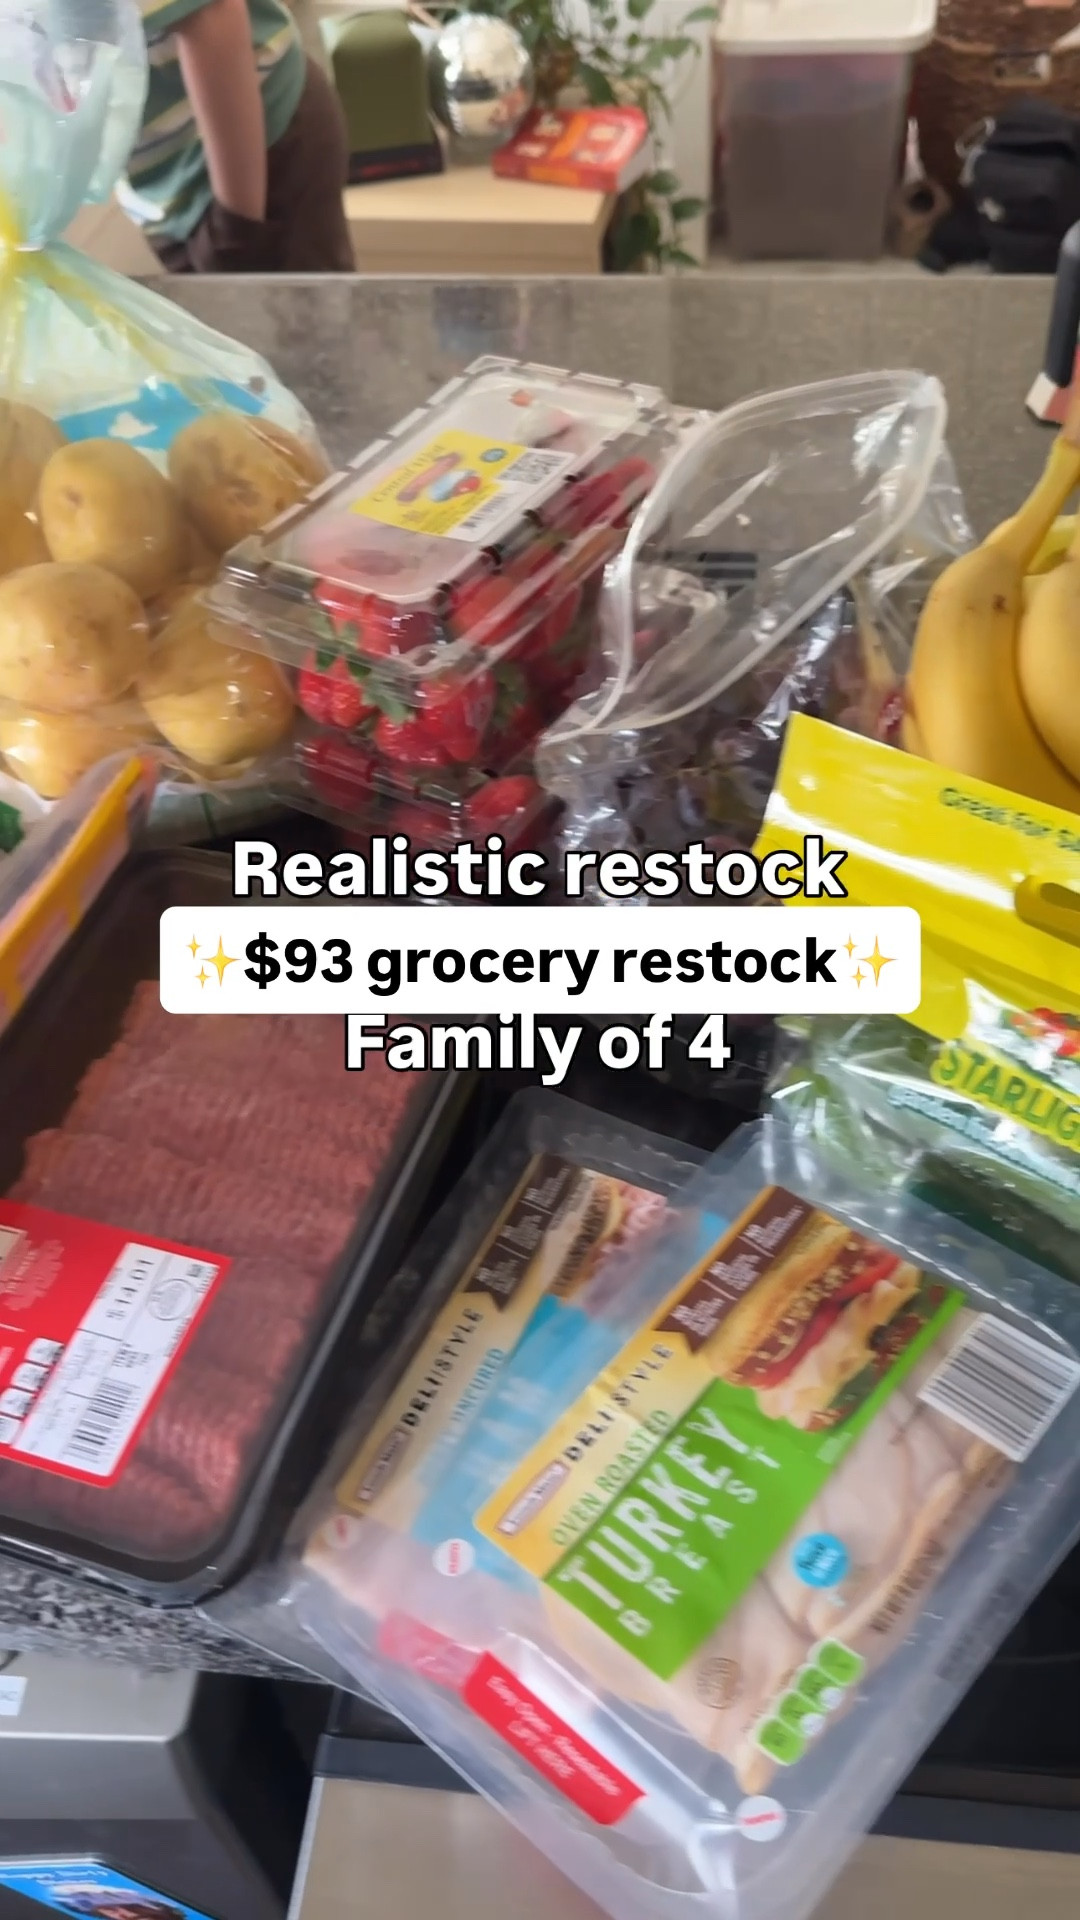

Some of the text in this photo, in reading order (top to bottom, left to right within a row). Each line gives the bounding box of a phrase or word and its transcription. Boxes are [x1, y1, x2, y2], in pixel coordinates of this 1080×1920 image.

[939, 787, 1008, 826] Great
[105, 1259, 155, 1320] $14.01
[432, 1306, 483, 1372] STYLE
[563, 1339, 674, 1464] DELI STYLE
[547, 1405, 673, 1548] OVEN ROASTED
[557, 1406, 751, 1611] TURKEY
[617, 1446, 781, 1637] BREAST
